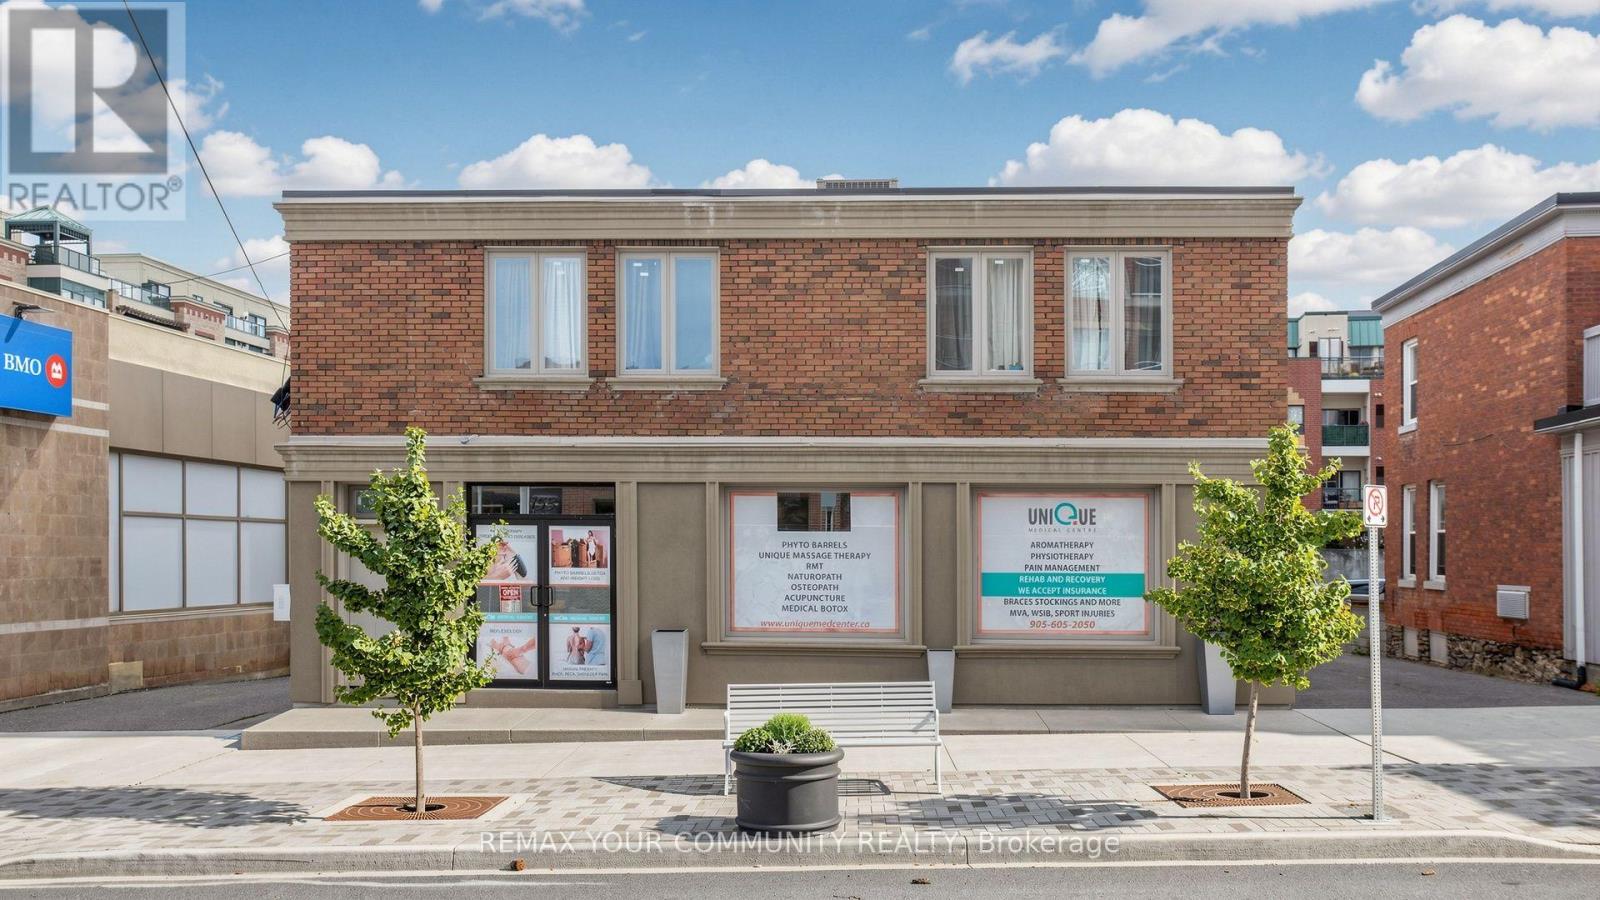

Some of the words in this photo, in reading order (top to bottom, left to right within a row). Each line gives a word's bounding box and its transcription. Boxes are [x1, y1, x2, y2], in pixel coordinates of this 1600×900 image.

[3, 352, 42, 376] BMO
[1028, 502, 1097, 526] UNIQUE
[782, 541, 810, 549] PHYTO
[811, 541, 848, 549] BARRELS
[1030, 541, 1095, 549] AROMATHERAPY
[758, 552, 791, 560] UNIQUE
[793, 552, 832, 560] MASSAGE
[835, 552, 871, 560] THERAPY
[1030, 552, 1095, 561] PHYSIOTHERAPY
[1024, 564, 1043, 572] PAIN
[1045, 564, 1101, 572] MANAGEMENT
[787, 573, 843, 581] NATUROPATH
[1019, 575, 1045, 584] REHAB
[1047, 575, 1064, 584] AND
[1065, 575, 1106, 584] RECOVERY
[1018, 587, 1030, 595] WE
[1031, 587, 1061, 595] ACCEPT
[1062, 587, 1107, 595] INSURANCE
[784, 594, 846, 602] ACUPUNCTURE
[1003, 598, 1033, 606] BRACES
[1034, 598, 1078, 606] STOCKINGS
[1079, 598, 1097, 606] AND
[1098, 598, 1121, 606] MORE
[781, 605, 819, 613] MEDICAL
[820, 605, 849, 613] BOTOX
[1009, 609, 1030, 618] MVA,
[1031, 609, 1053, 618] WSIB,
[1054, 609, 1079, 618] SPORT
[1081, 609, 1115, 618] INJURIES
[760, 619, 871, 629] www.uniquemedcenter.ca
[1029, 620, 1096, 629] 905-605-2050
